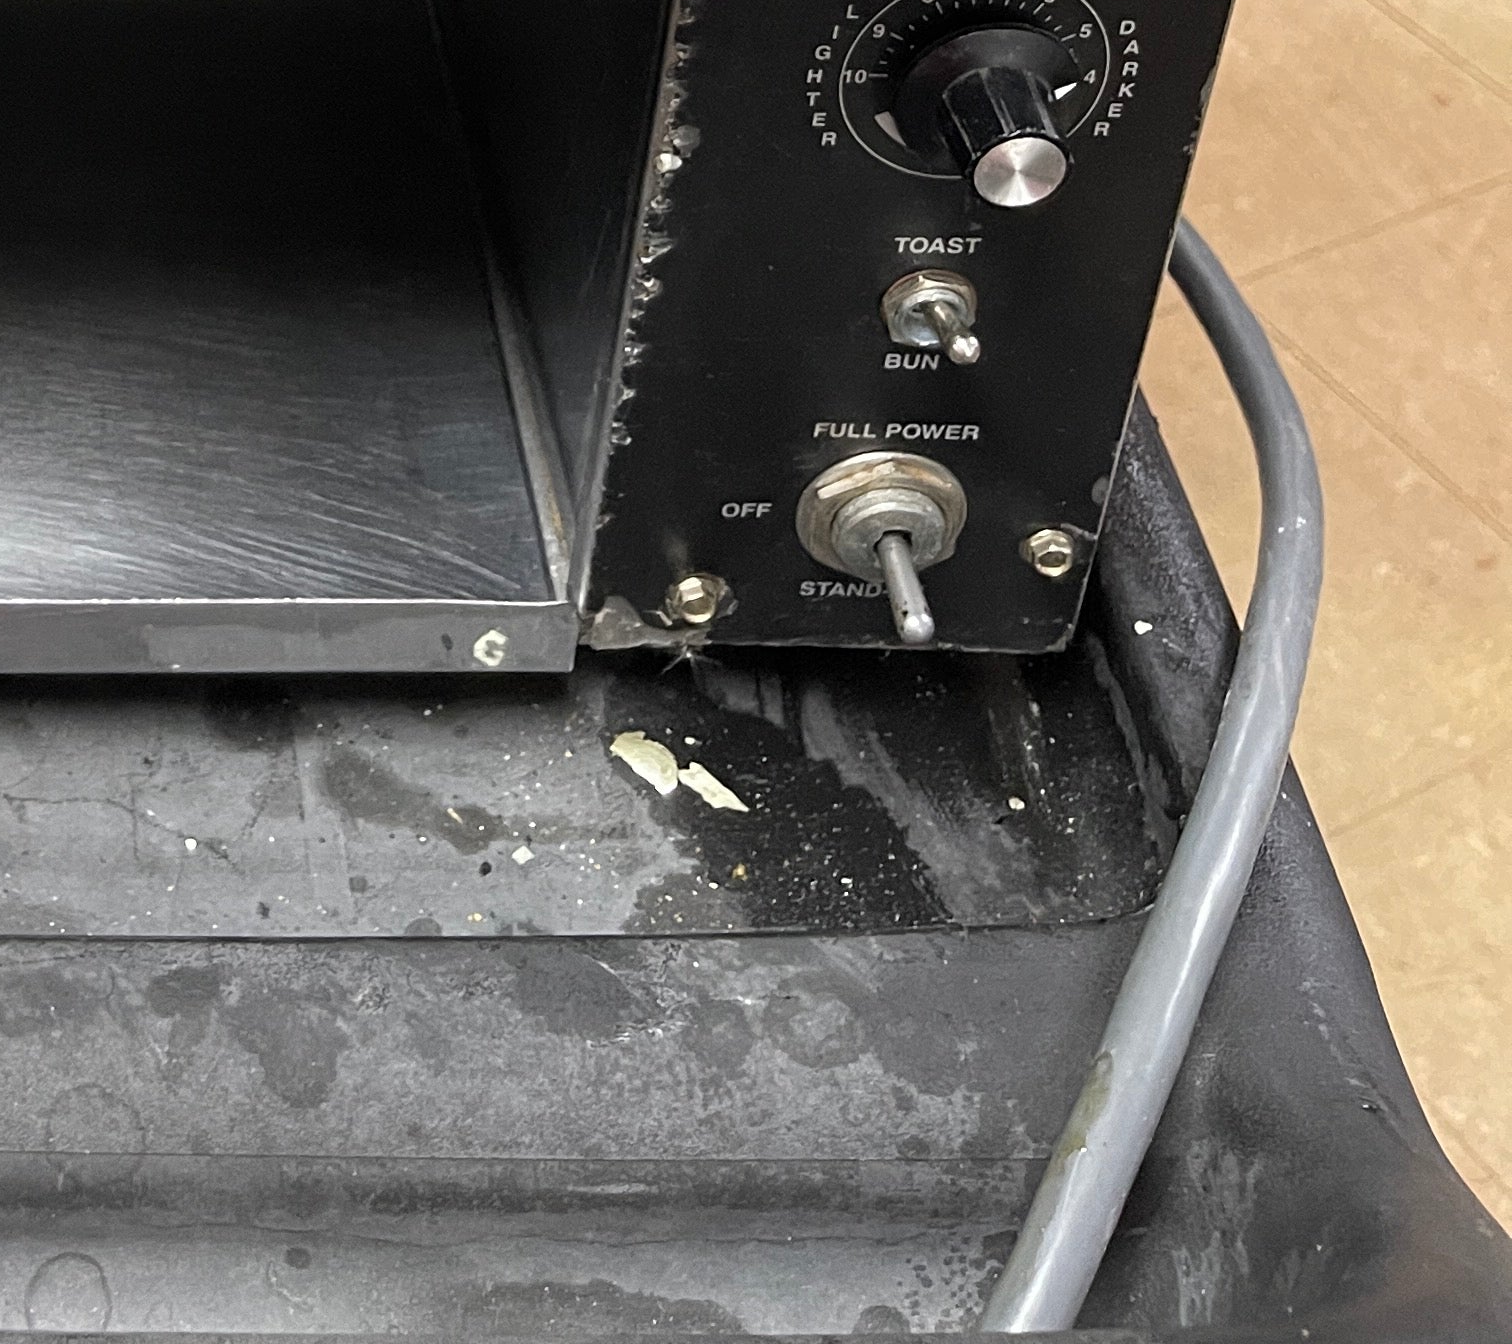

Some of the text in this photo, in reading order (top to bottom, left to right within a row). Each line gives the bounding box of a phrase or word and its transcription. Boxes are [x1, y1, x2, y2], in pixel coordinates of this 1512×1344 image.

[873, 24, 885, 37] 9
[1080, 24, 1092, 38] 5
[844, 69, 867, 85] 10
[1083, 69, 1096, 84] 4
[895, 237, 981, 253] TOAST
[885, 354, 939, 369] BUN
[814, 423, 979, 439] FULL POWER
[722, 503, 772, 517] OFF
[799, 580, 889, 599] STAND-
